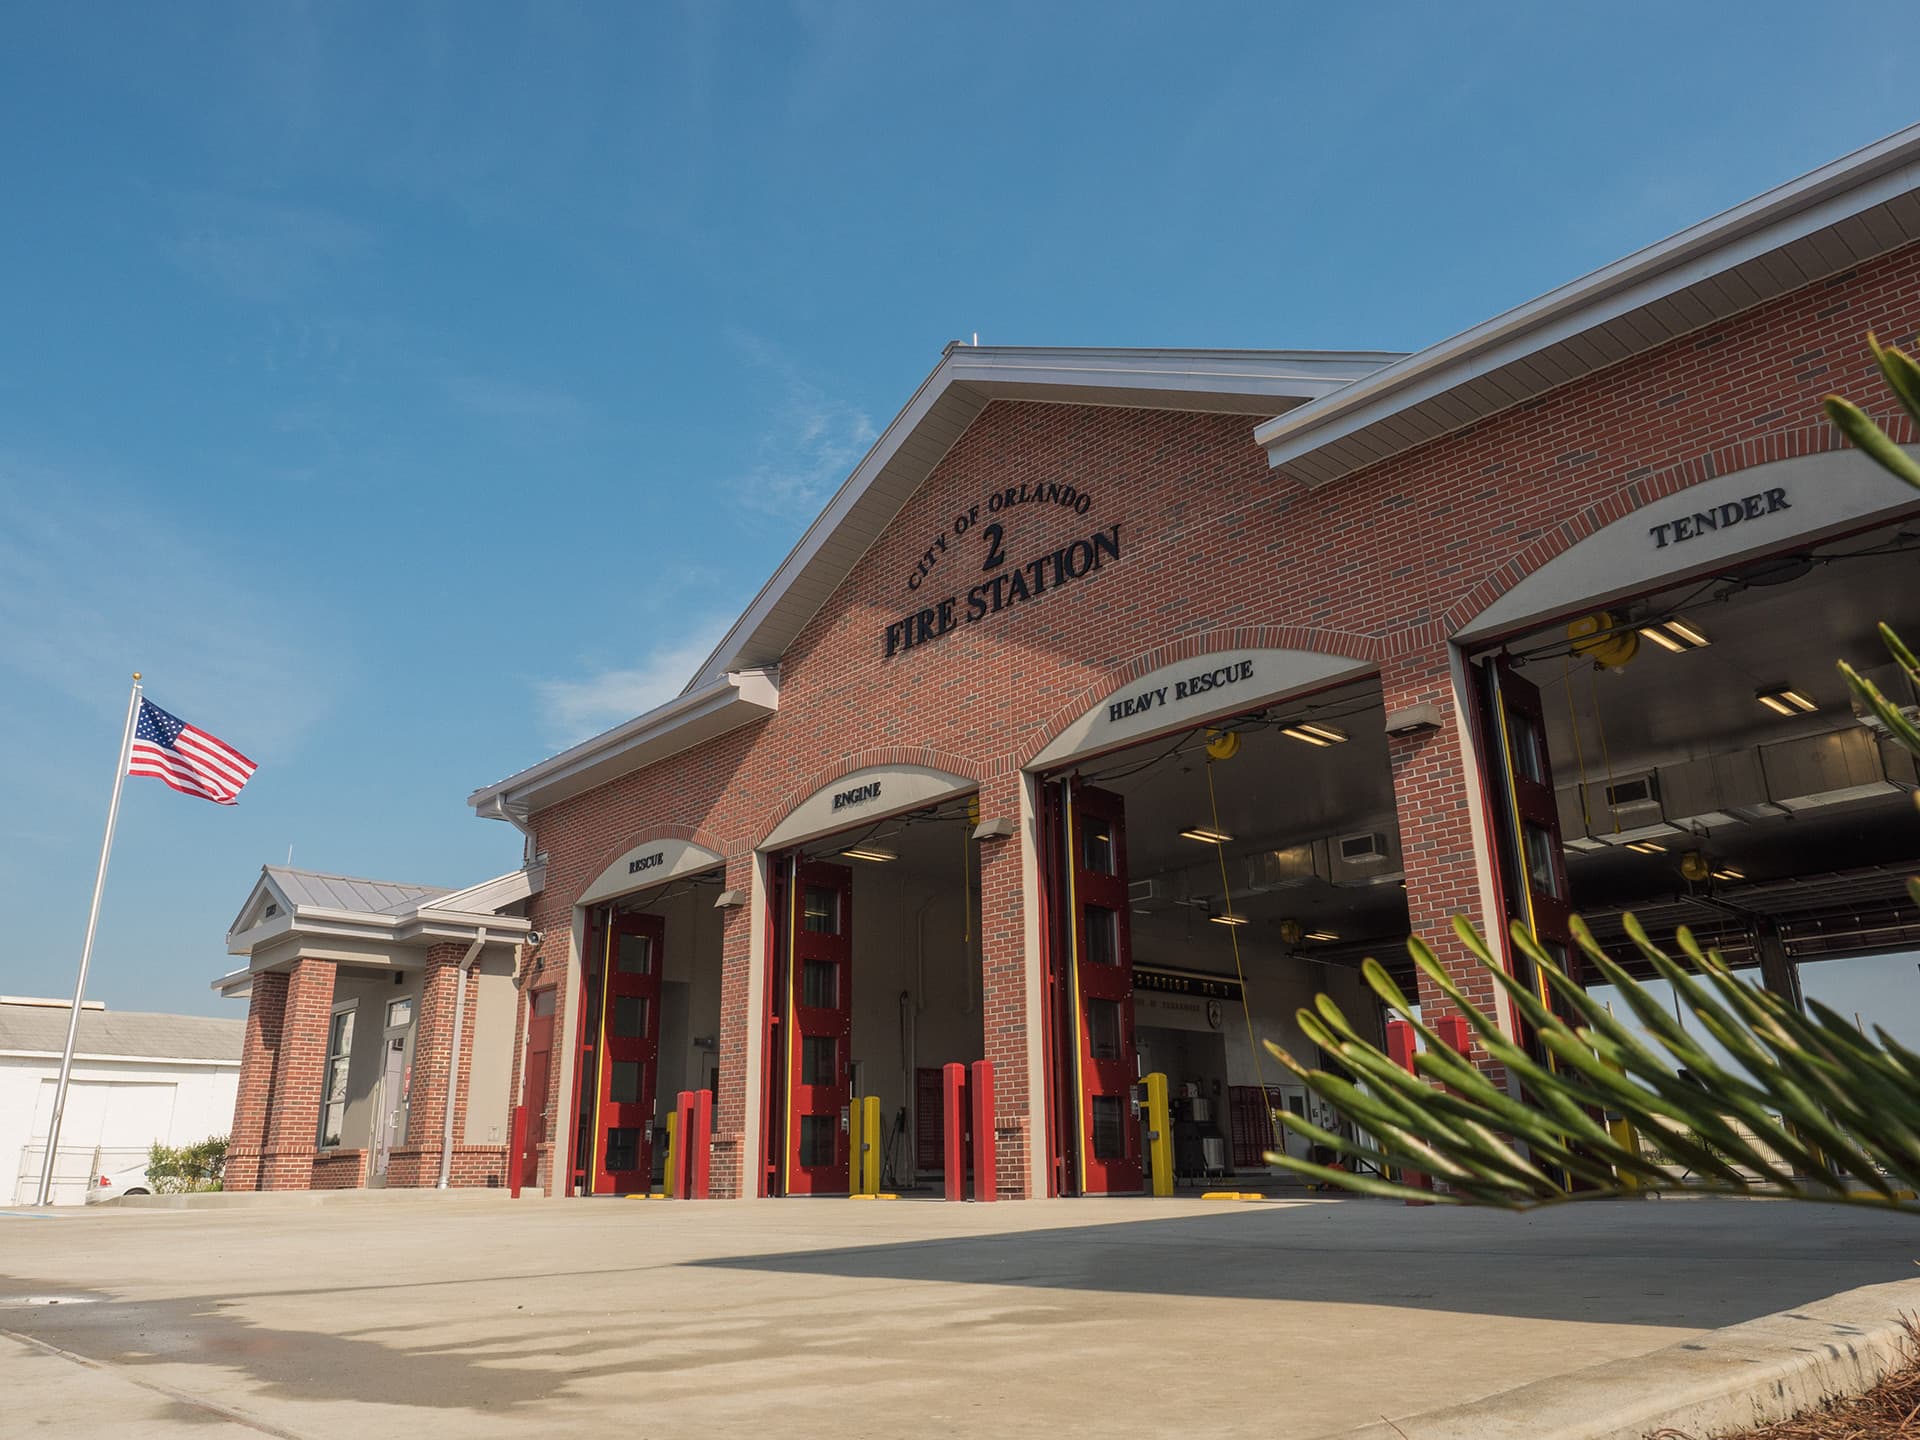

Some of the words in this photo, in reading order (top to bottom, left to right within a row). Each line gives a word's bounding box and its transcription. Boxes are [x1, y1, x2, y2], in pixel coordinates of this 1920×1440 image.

[907, 532, 949, 591] CITY
[954, 504, 981, 536] OF
[988, 482, 1092, 515] ORLANDO
[982, 522, 1005, 571] 2
[1649, 487, 1792, 549] TENDER
[884, 596, 958, 658] FIRE
[966, 523, 1122, 623] STATION
[1109, 686, 1169, 722] HEAVY
[1175, 659, 1254, 701] RESCUE
[834, 781, 882, 809] ENGINE
[629, 851, 664, 874] RESCUE
